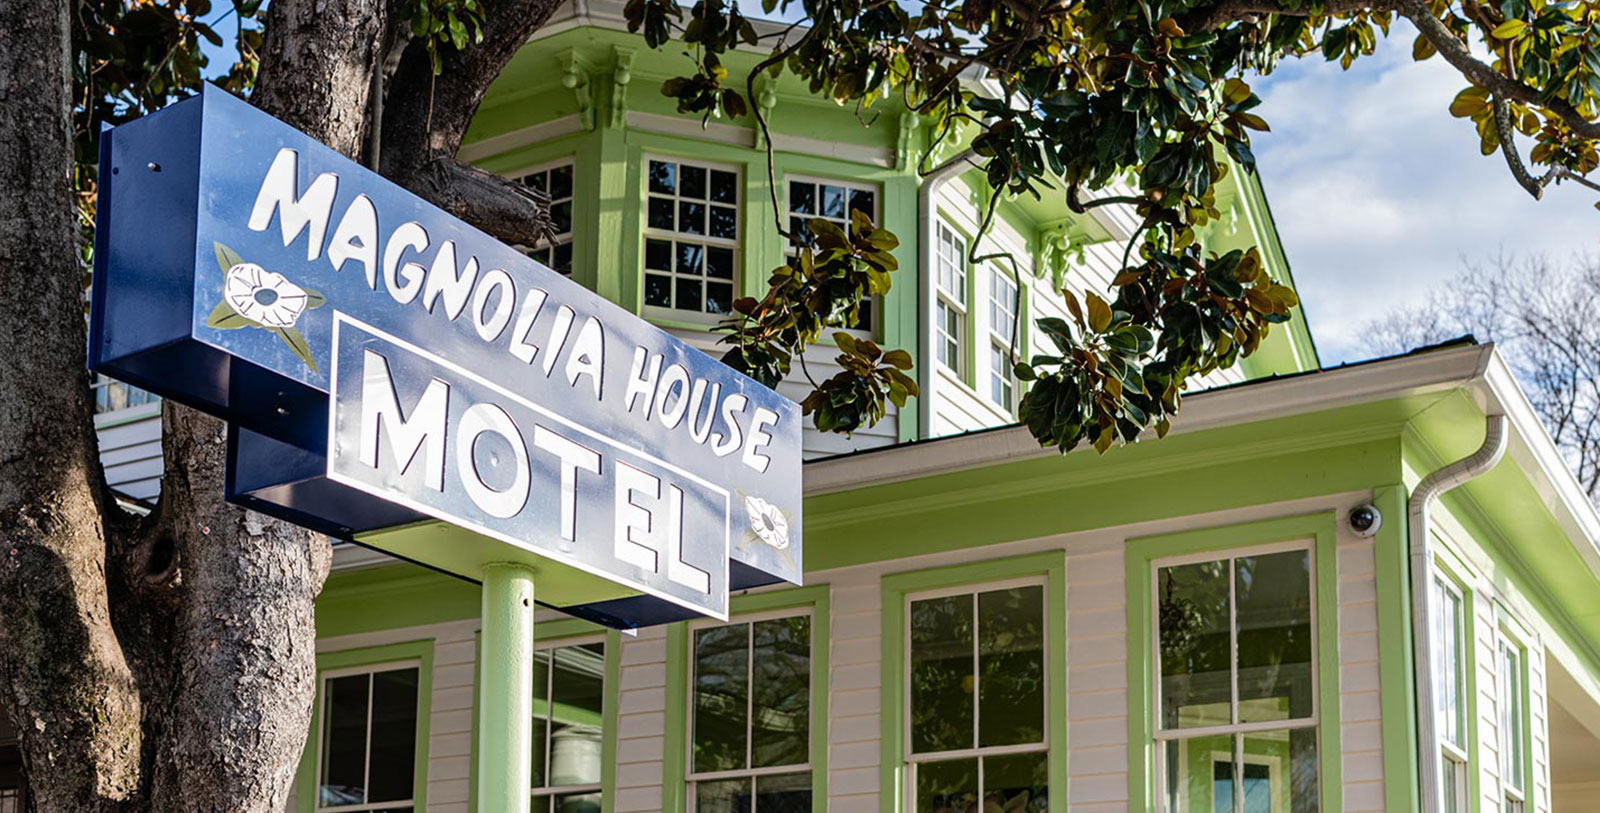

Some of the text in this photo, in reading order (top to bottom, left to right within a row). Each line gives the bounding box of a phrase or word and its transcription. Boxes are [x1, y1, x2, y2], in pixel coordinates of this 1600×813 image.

[249, 147, 781, 474] MAGNOLIA HOUSE
[359, 349, 711, 595] MOTEL
